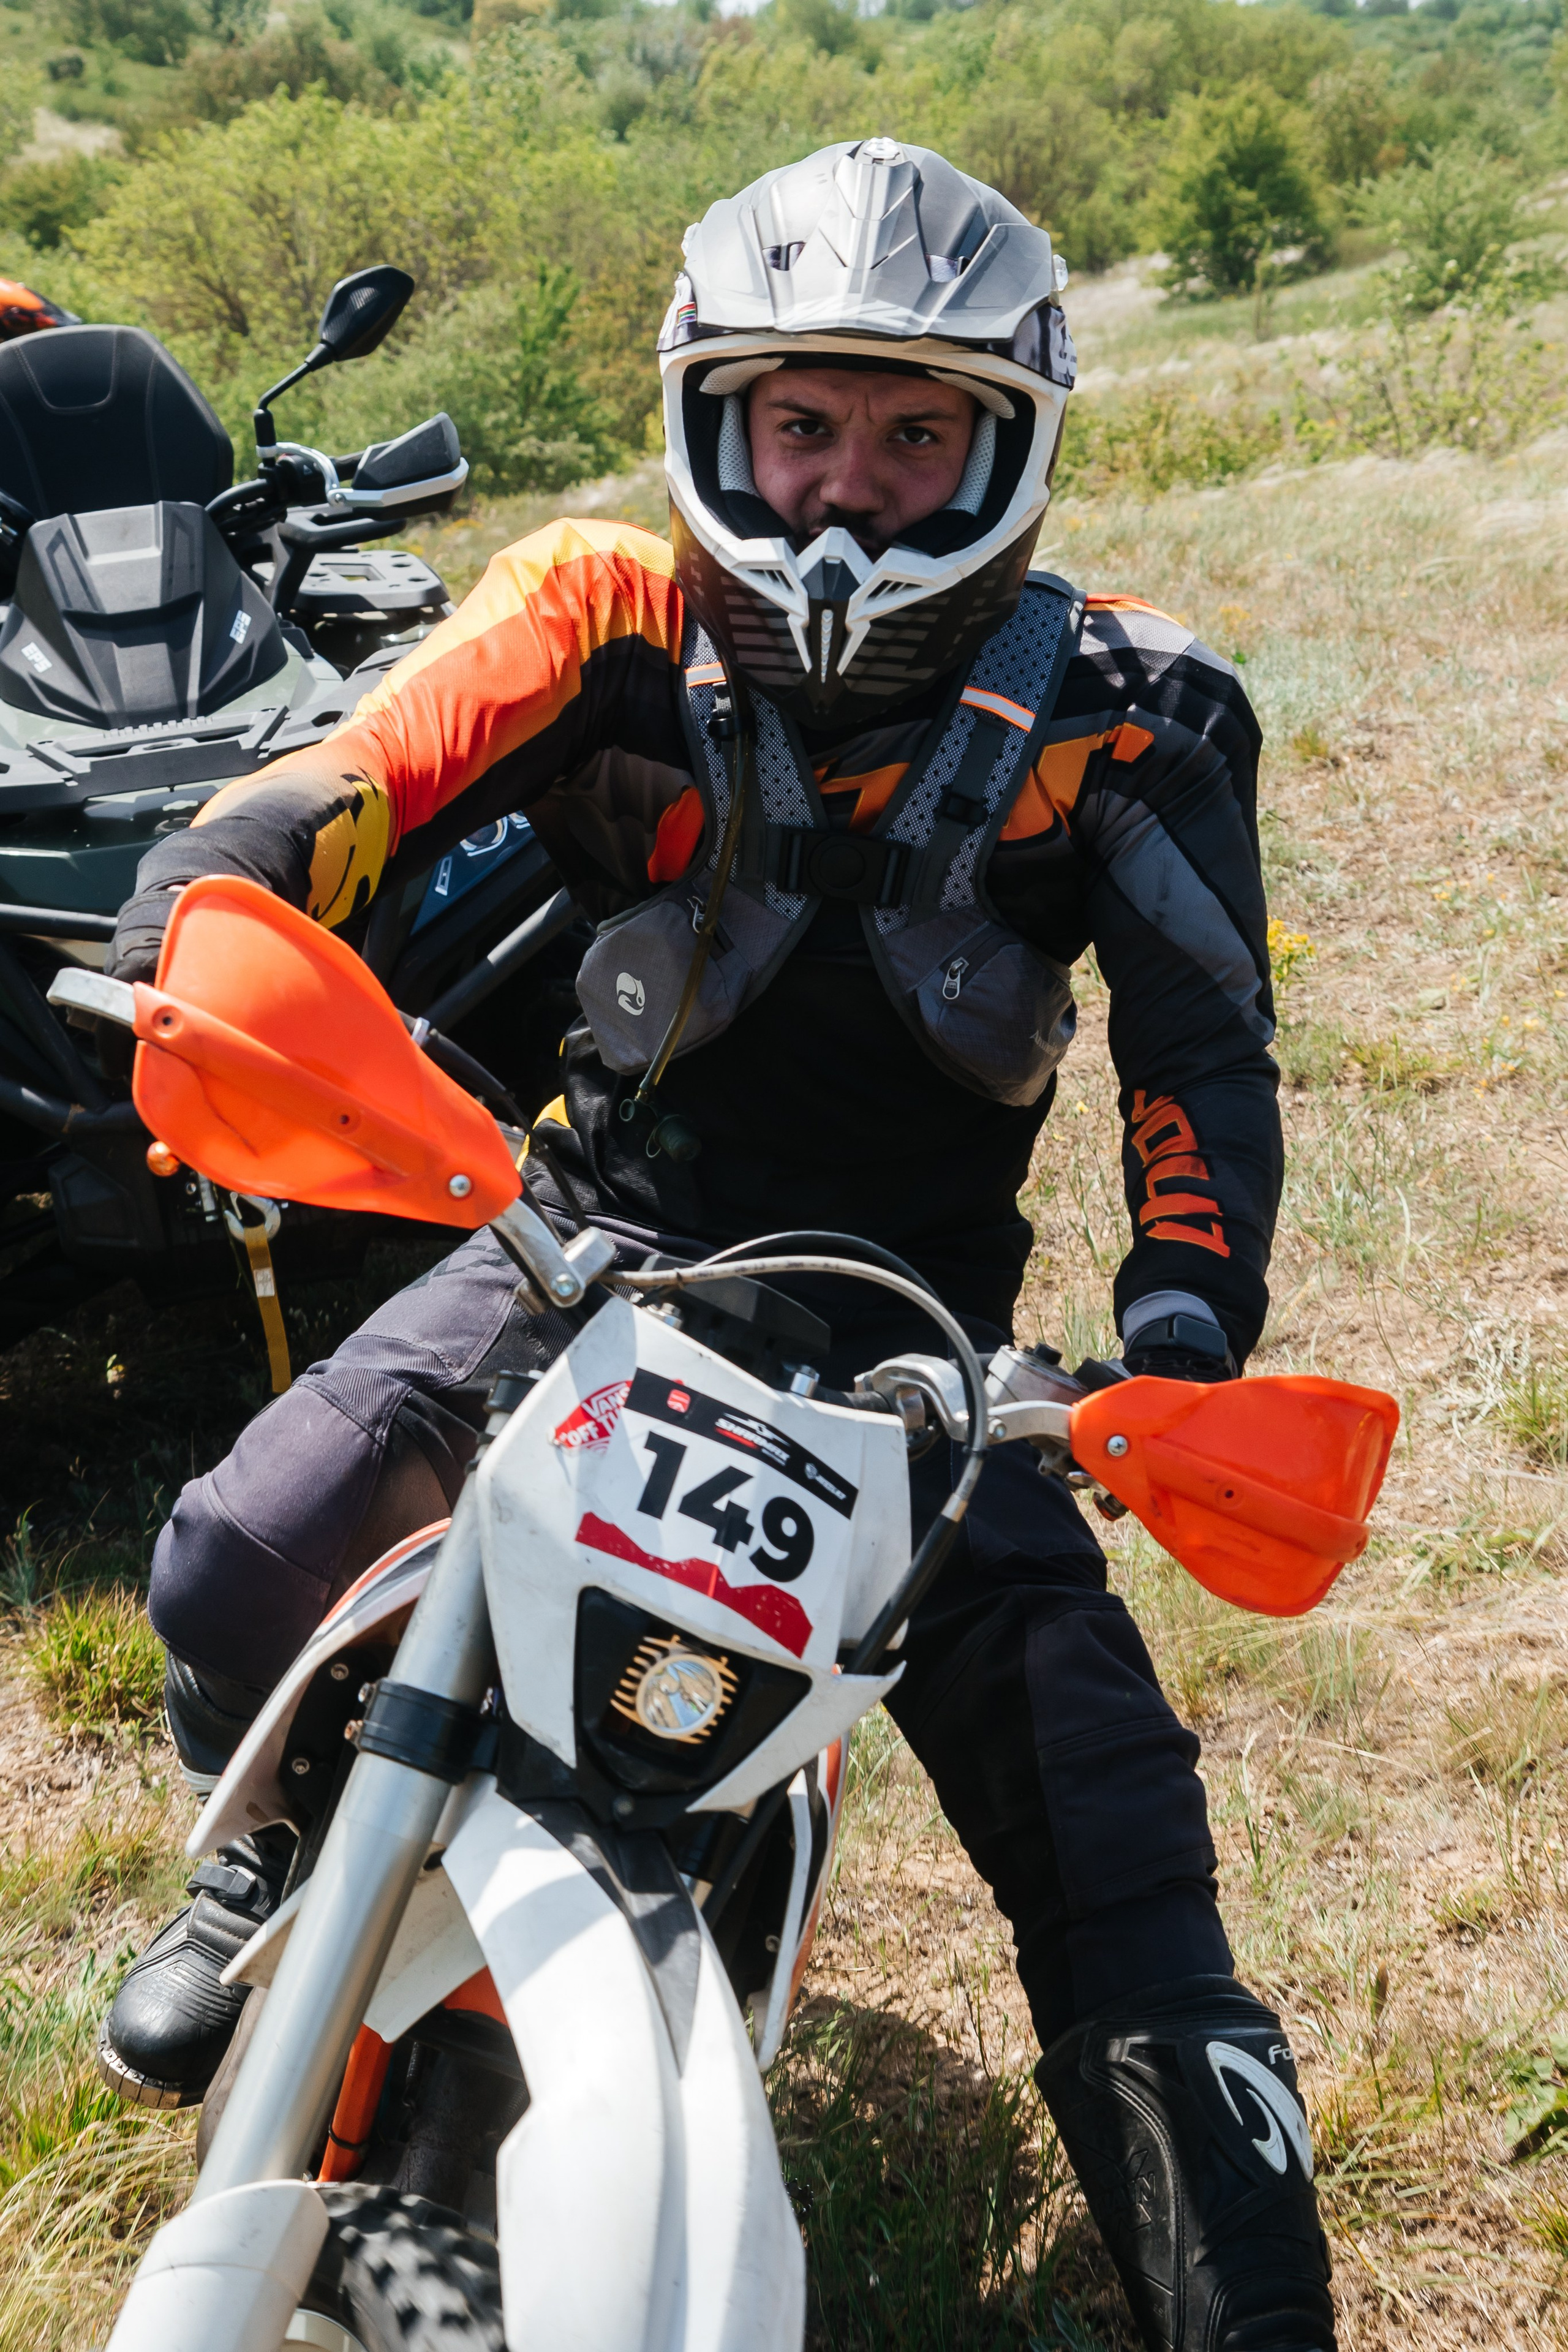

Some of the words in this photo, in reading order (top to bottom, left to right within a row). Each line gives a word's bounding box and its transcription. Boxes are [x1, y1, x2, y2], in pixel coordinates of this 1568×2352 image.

[230, 609, 252, 644] EPS
[21, 641, 53, 673] EPS
[581, 1381, 630, 1420] VANS
[636, 1430, 815, 1583] 149
